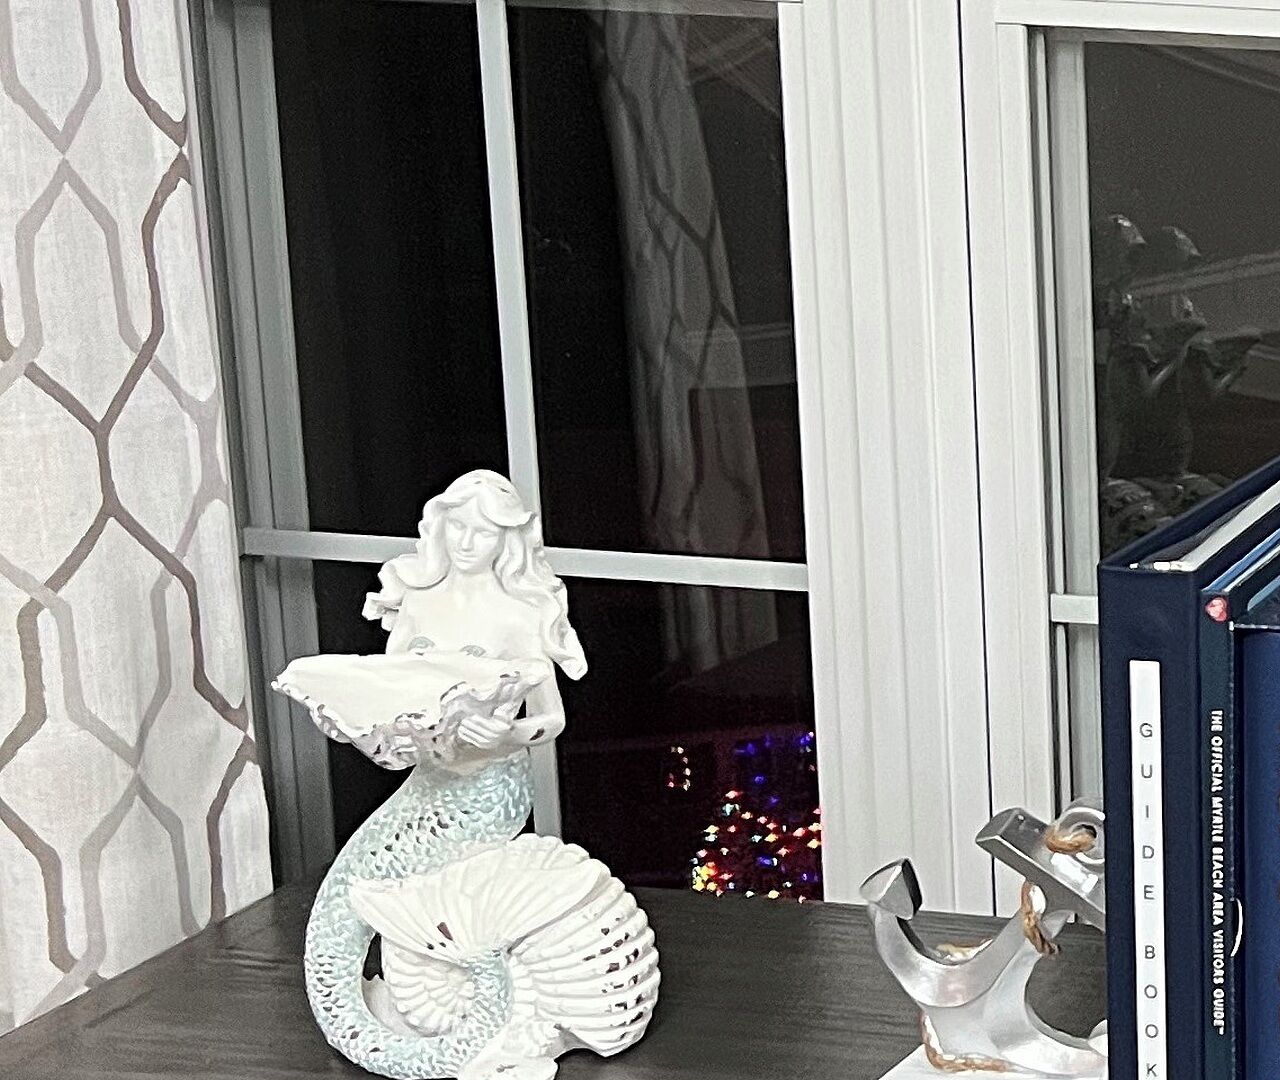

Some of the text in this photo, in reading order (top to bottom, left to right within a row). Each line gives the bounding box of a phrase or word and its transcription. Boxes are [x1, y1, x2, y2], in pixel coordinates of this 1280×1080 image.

[1211, 709, 1223, 732] THE
[1210, 735, 1224, 792] OFFICIAL
[1211, 797, 1224, 842] MYRTLE
[1211, 847, 1224, 889] BEACH
[1139, 722, 1159, 1078] GUIDE BOOK
[1212, 892, 1224, 927] AREA
[1212, 928, 1225, 985] VISITORS
